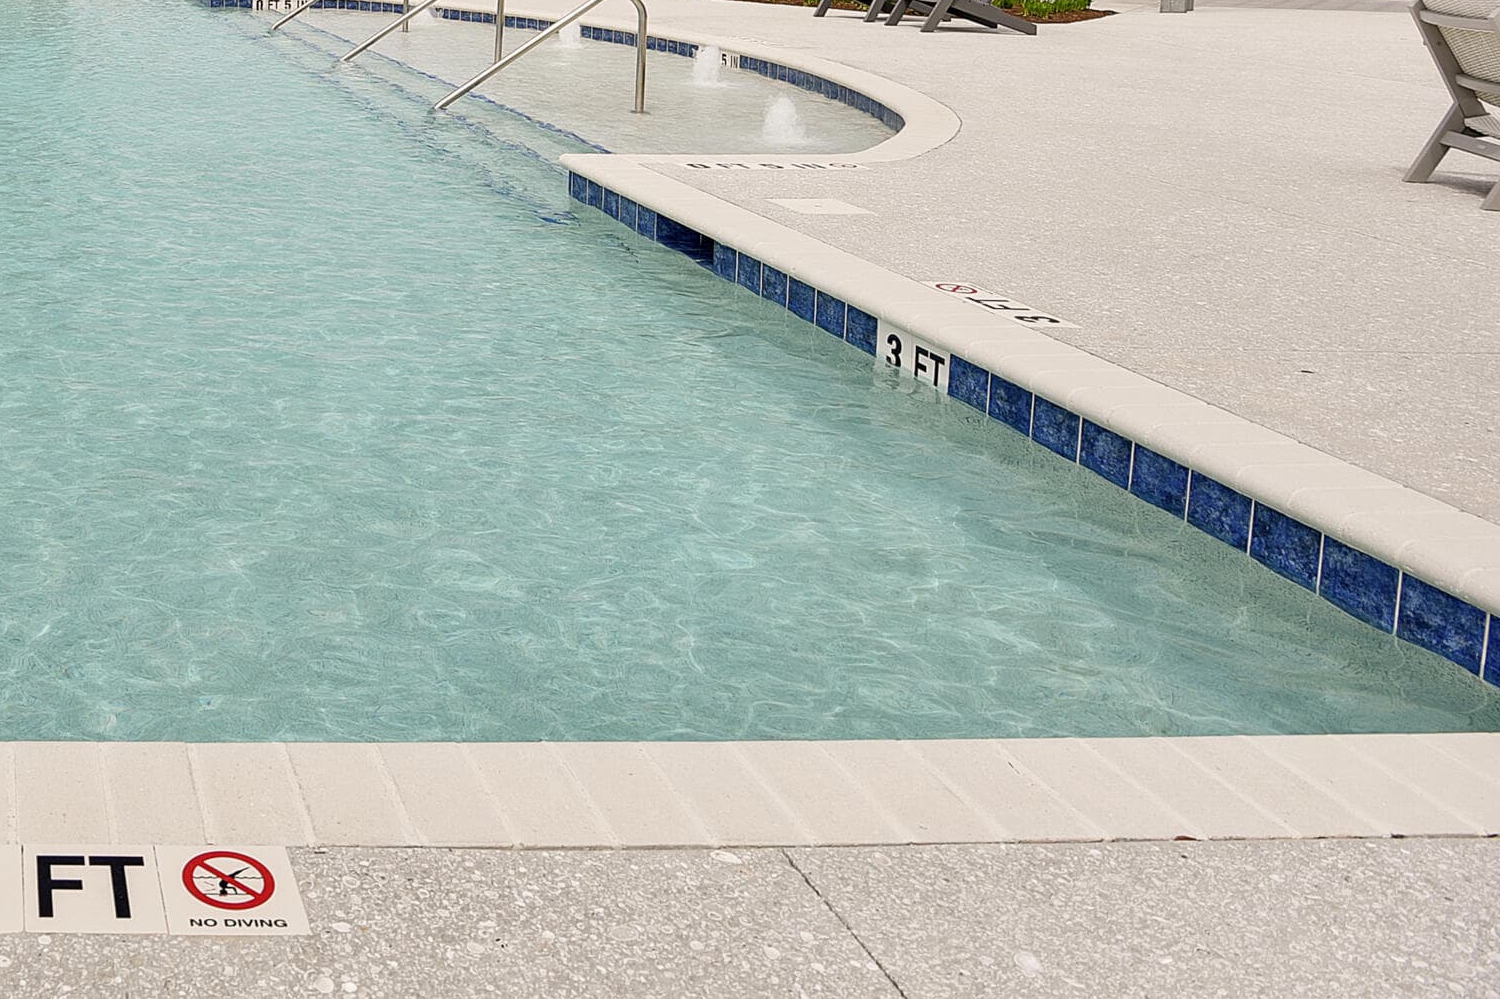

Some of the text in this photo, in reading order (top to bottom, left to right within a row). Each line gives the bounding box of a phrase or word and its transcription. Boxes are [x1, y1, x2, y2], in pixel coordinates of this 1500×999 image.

[268, 0, 279, 9] FT
[284, 0, 291, 9] 5
[722, 53, 727, 65] 5
[886, 334, 945, 387] 3 FT
[36, 855, 144, 918] FT
[190, 918, 288, 928] NO DIVING
